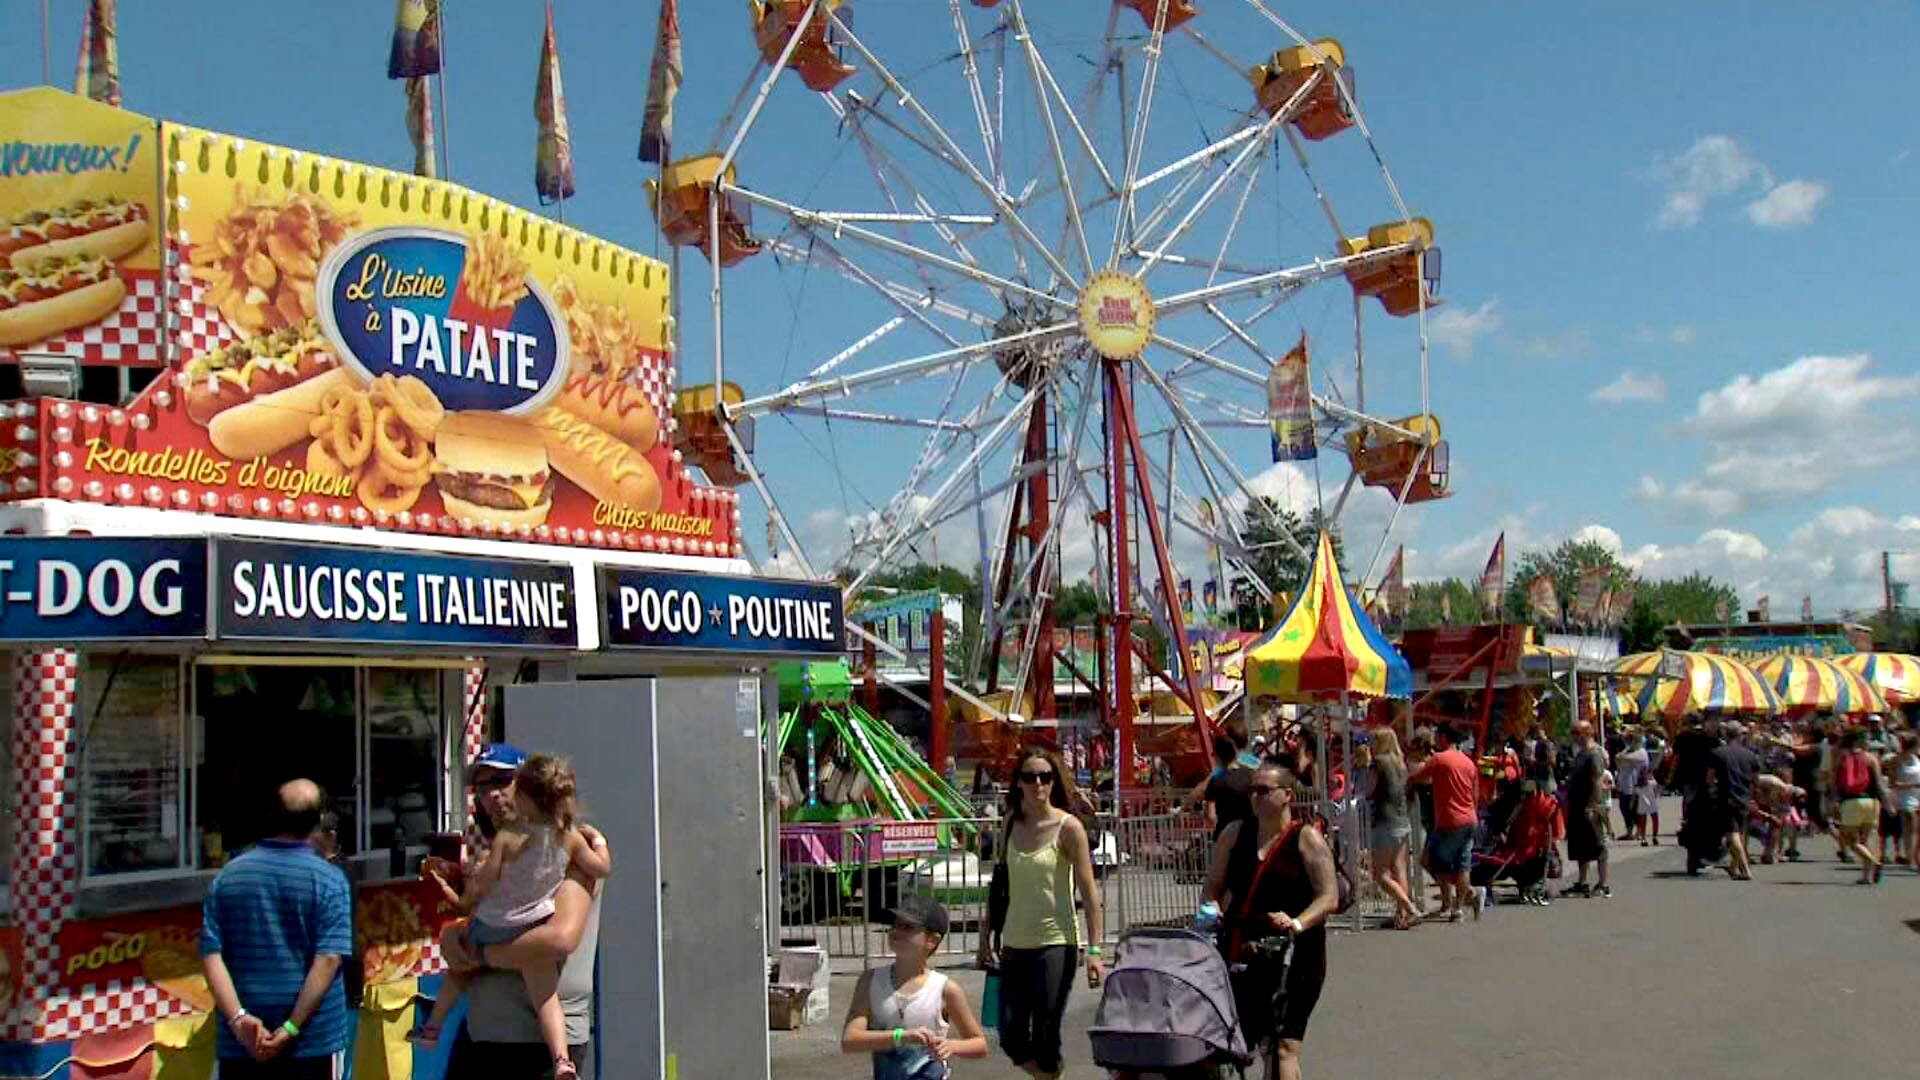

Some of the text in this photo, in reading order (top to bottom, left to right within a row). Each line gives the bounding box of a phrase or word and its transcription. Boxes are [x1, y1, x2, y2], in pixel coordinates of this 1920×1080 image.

[346, 254, 446, 300] L'Usine
[365, 306, 538, 391] à PATATE
[84, 437, 354, 499] Rondelles d'oignon
[592, 500, 713, 536] Chips maison
[233, 560, 569, 630] SAUCISSE ITALIENNE
[620, 585, 836, 641] POGO POUTINE
[66, 932, 145, 976] POGO
